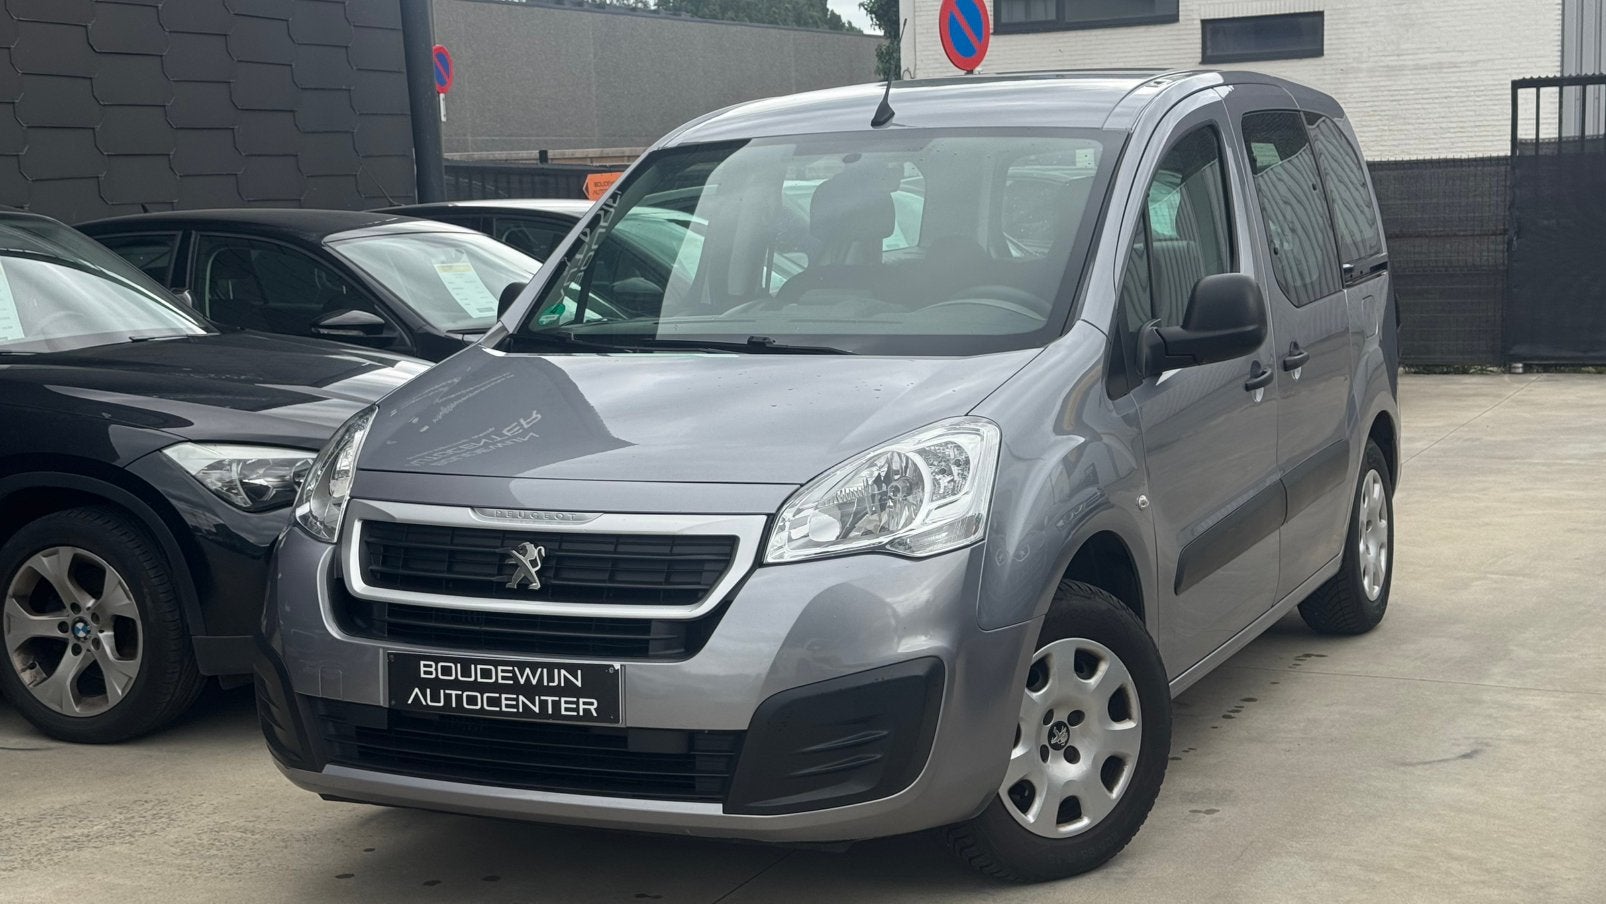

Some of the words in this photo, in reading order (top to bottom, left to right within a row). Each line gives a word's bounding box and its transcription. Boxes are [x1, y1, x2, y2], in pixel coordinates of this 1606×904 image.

[495, 509, 577, 521] PEUGEOT
[419, 660, 581, 687] BOUDEWIJN
[407, 687, 598, 716] AUTOCENTER
